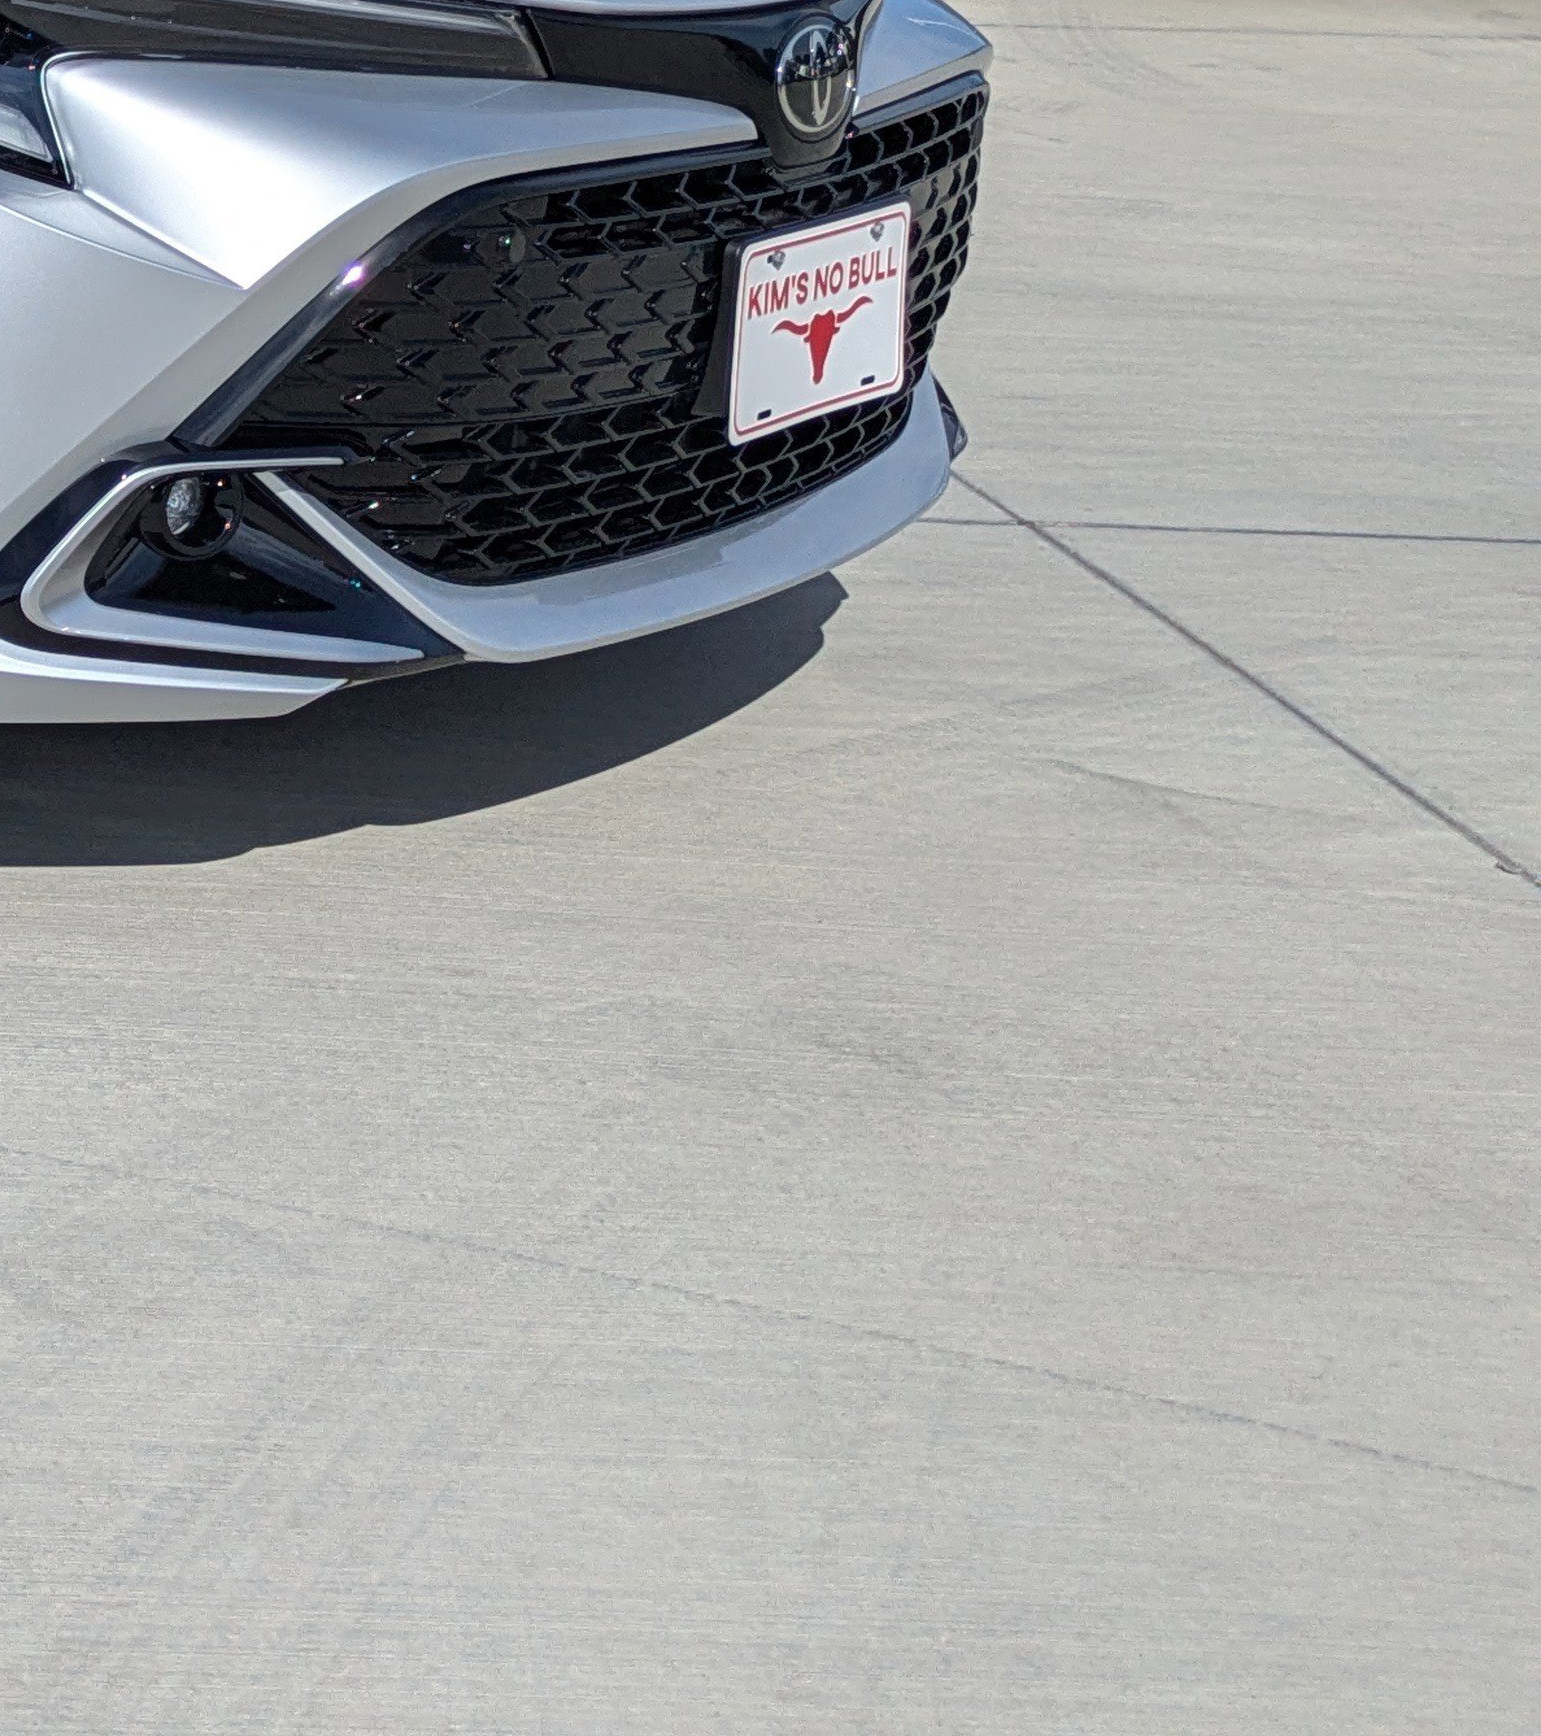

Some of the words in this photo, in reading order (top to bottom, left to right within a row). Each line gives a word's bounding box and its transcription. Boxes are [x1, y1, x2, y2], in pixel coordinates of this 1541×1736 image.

[748, 271, 808, 320] KIM'S
[813, 262, 844, 301] NO
[848, 246, 897, 290] BULL
